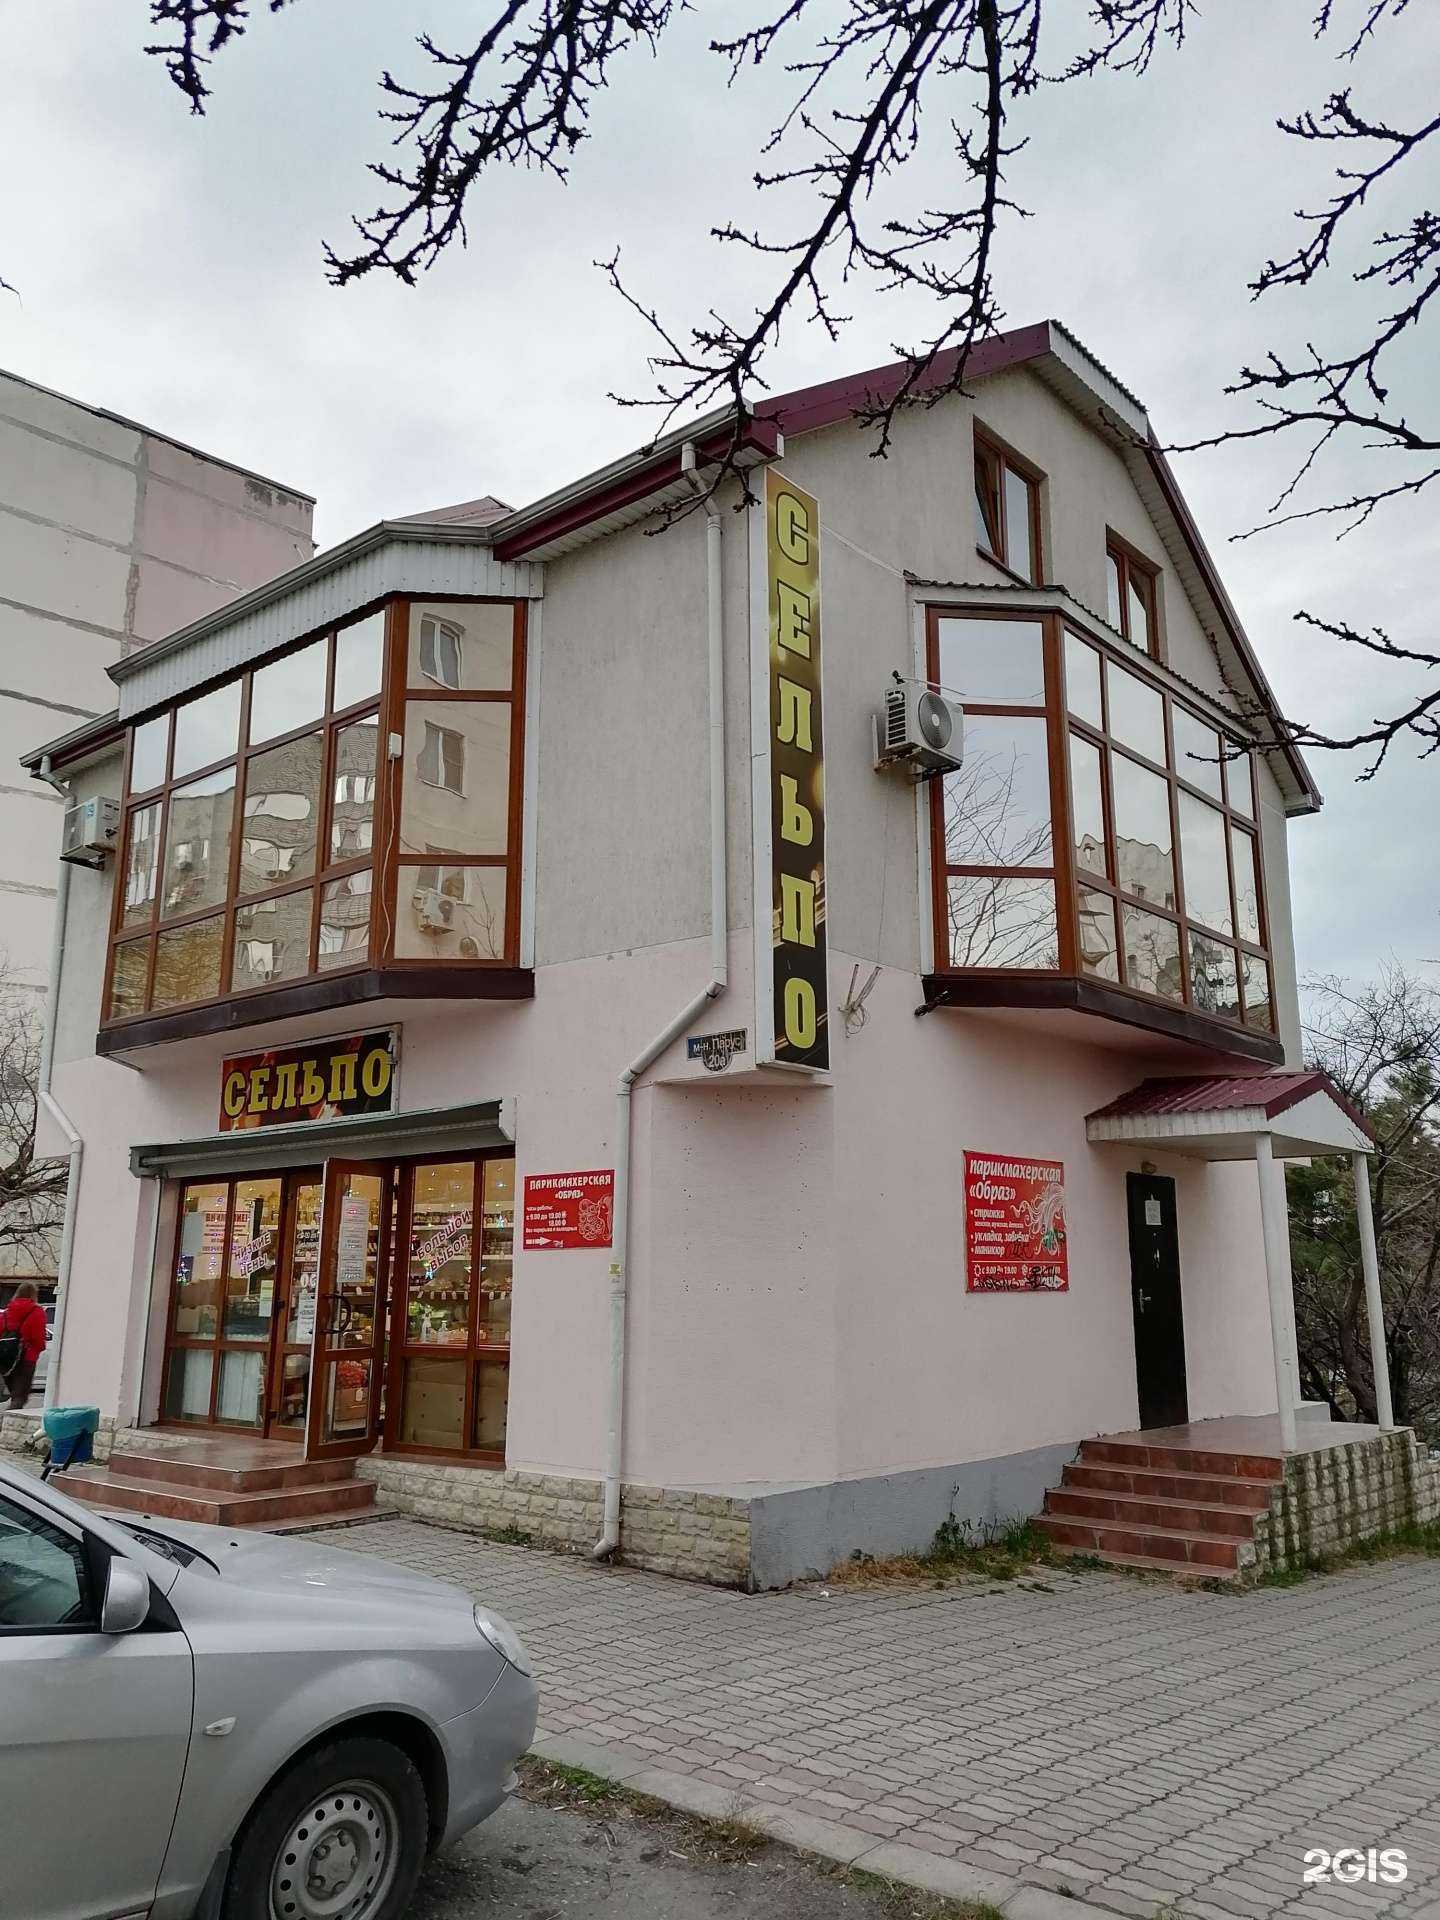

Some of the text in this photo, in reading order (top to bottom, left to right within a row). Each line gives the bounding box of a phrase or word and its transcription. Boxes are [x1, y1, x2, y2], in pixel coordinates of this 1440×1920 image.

[775, 491, 817, 1049] СЕЛЬПО
[224, 1048, 391, 1117] СЕЛЬПО
[529, 1174, 611, 1191] ПАРИКМАХЕРСКАЯ
[969, 1159, 1062, 1185] парикмахерская
[235, 1232, 271, 1258] НИЗКИЕ
[417, 1208, 471, 1259] БОЛЬШОЙ
[240, 1253, 268, 1276] ЦЕНЫ
[430, 1236, 468, 1271] ВЫБОР
